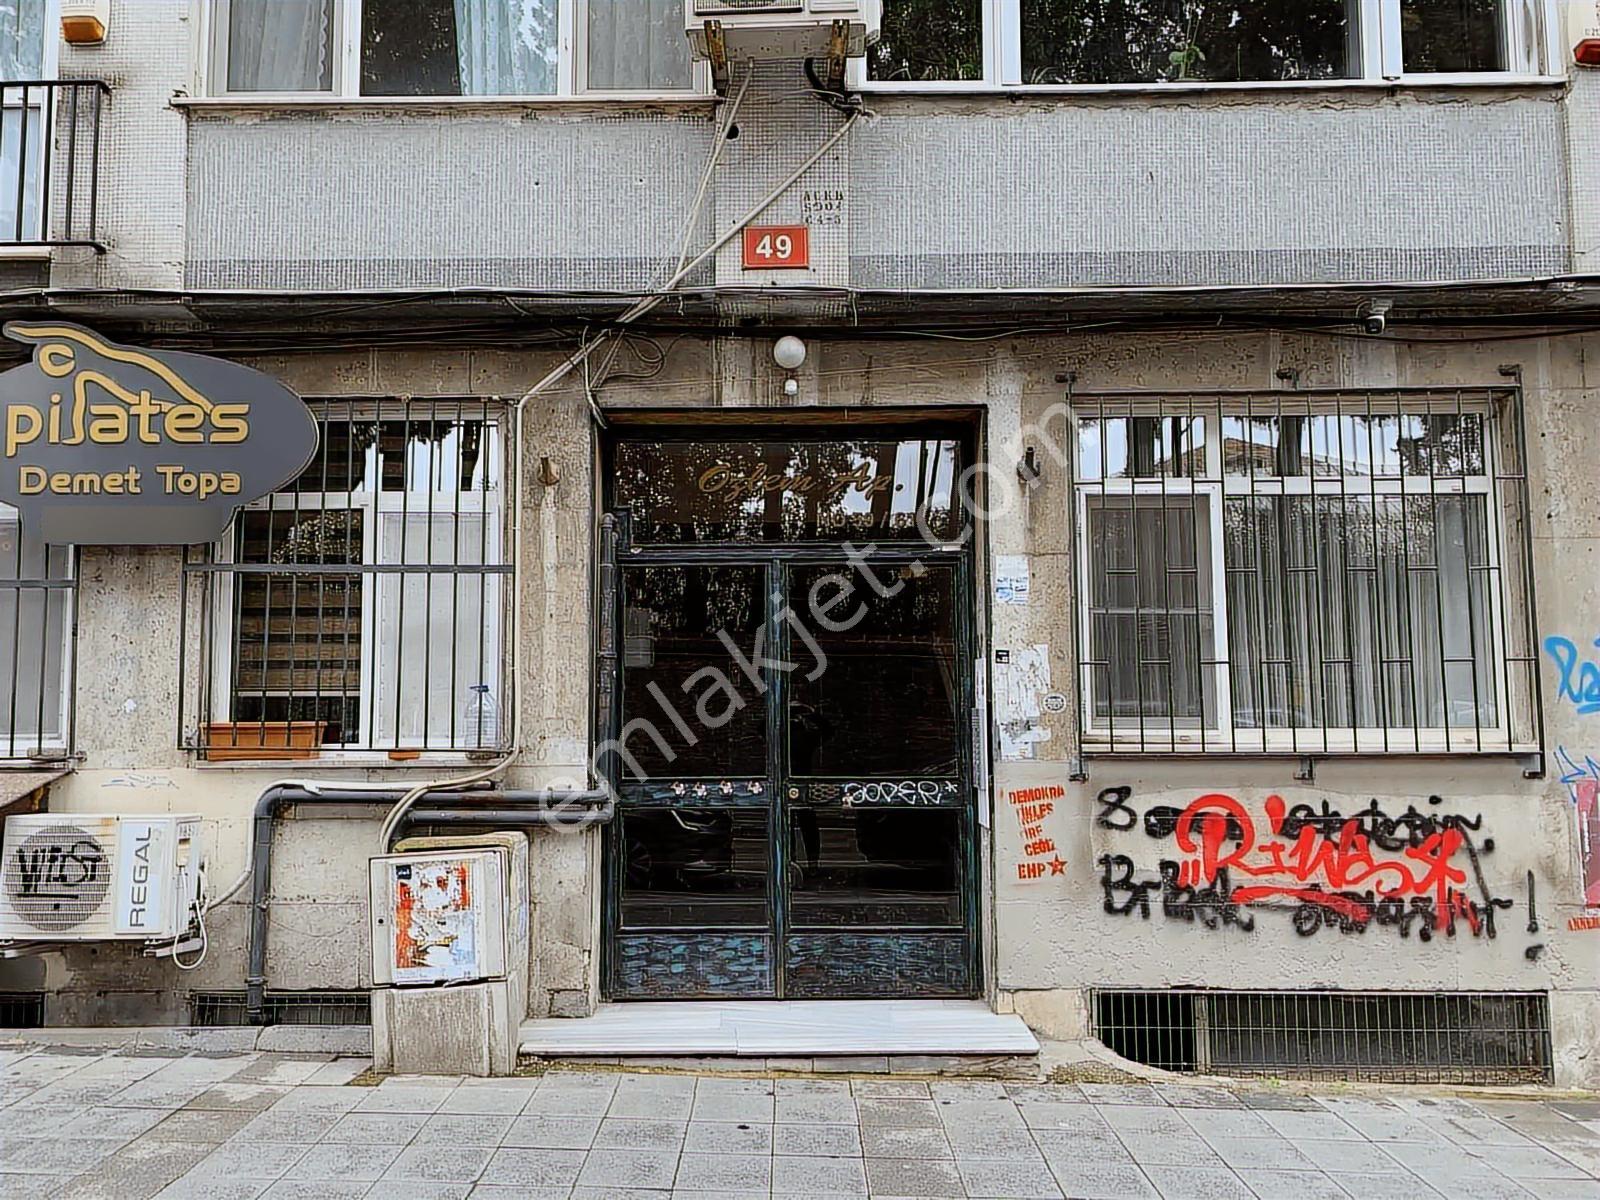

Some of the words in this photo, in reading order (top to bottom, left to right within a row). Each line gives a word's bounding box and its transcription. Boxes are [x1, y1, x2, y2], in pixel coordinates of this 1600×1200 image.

[755, 234, 793, 259] 49
[6, 386, 250, 457] pilates
[19, 466, 142, 495] Demet
[155, 466, 242, 500] Topa
[699, 459, 816, 503] Özlem
[1008, 784, 1065, 805] DEMOKRA
[129, 826, 152, 928] REGAL
[1017, 862, 1046, 879] EHP
